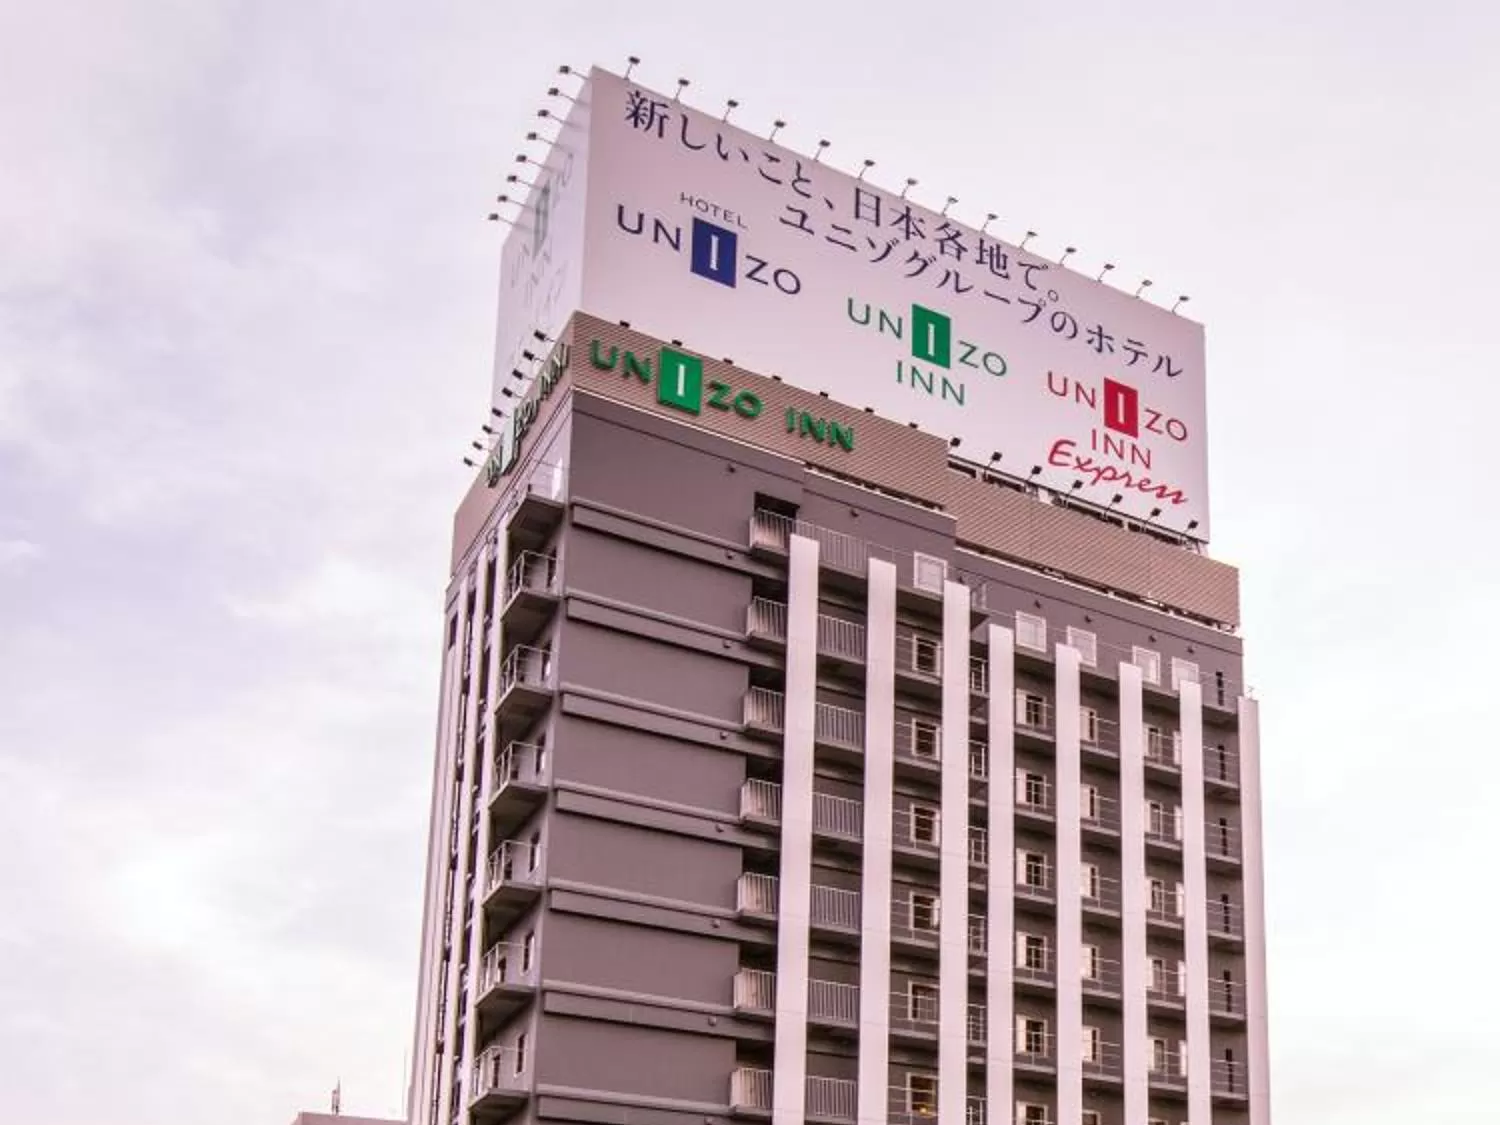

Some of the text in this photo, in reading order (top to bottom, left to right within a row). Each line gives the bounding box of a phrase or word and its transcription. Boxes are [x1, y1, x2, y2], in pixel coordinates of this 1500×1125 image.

[625, 90, 1059, 303] 新しいこと、日本各地で。
[680, 192, 748, 230] HOTEL
[617, 204, 801, 294] UNIZO
[779, 205, 1183, 378] ユニゾグループのホテル
[847, 298, 1008, 377] UNIZO
[589, 339, 854, 452] UNIZO INN
[896, 361, 965, 406] INN
[1048, 371, 1187, 441] UNIZO
[1048, 439, 1189, 504] Express
[1092, 429, 1151, 469] INN
